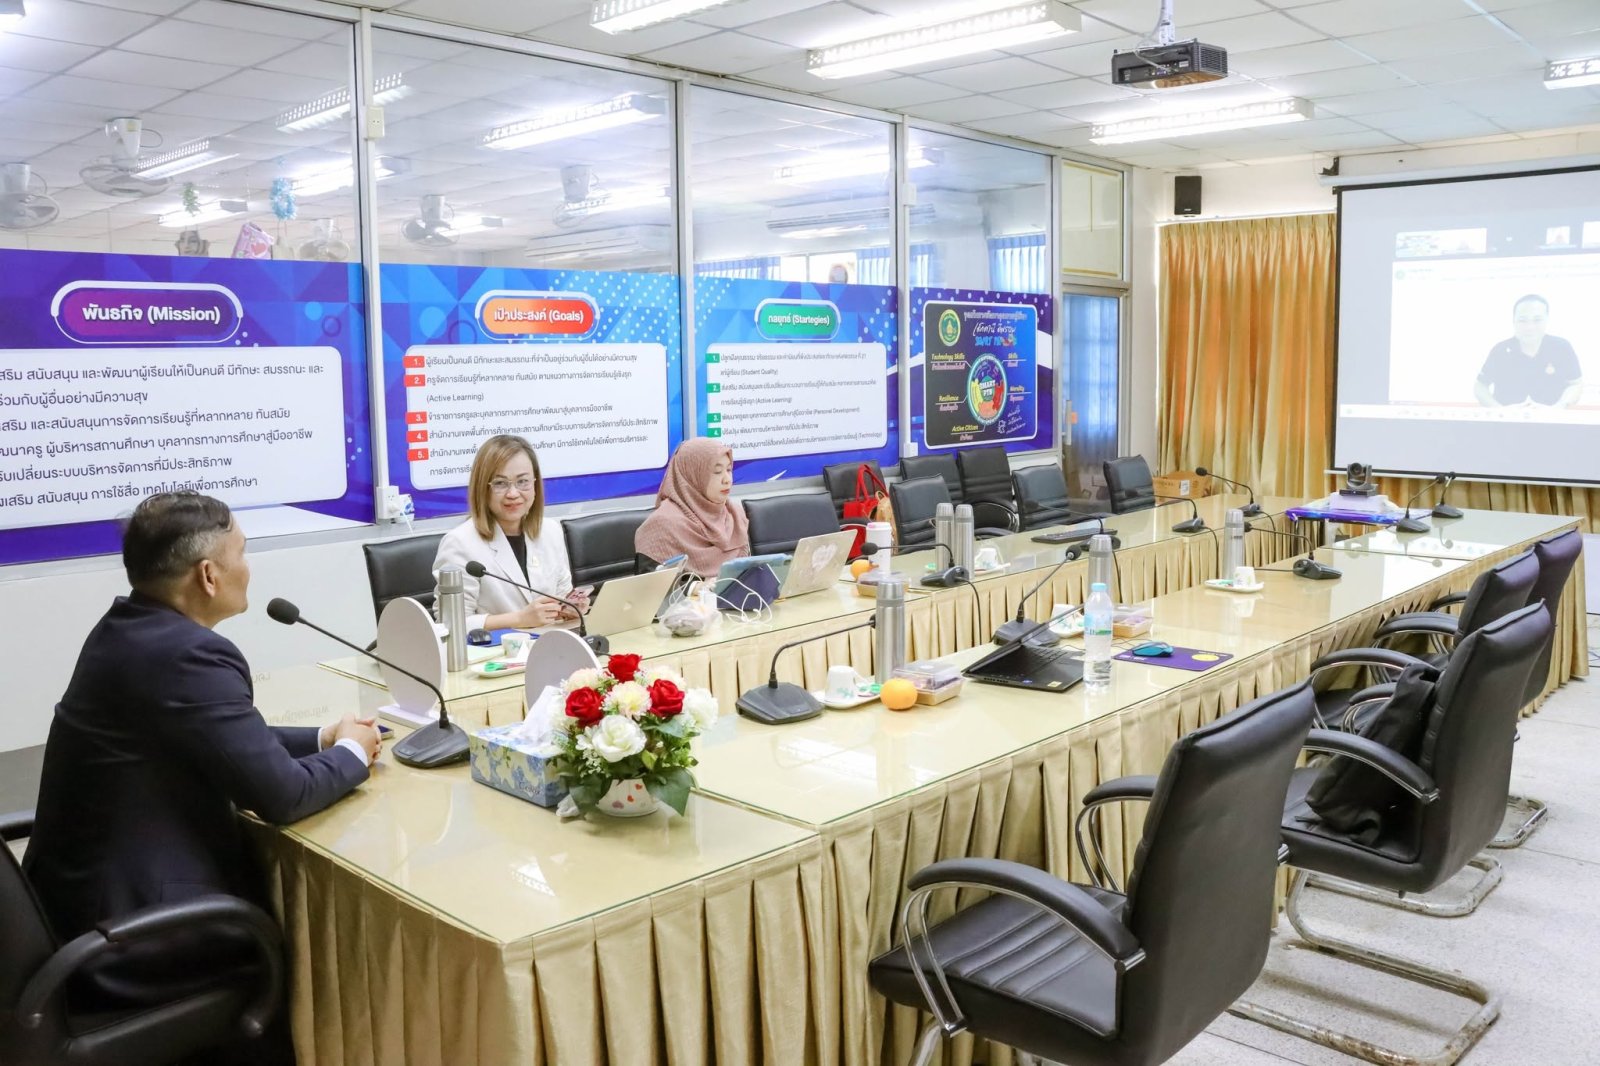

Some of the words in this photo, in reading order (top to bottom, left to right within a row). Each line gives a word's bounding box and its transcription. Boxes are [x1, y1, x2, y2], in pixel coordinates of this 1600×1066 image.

[82, 303, 143, 320] พันธกิจ
[147, 305, 221, 324] (Mission)
[494, 306, 547, 321] เป้าประสงค์
[549, 309, 584, 324] (Goals)
[26, 368, 79, 383] สนับสนุน
[227, 364, 261, 376] มีทักษะ
[263, 364, 306, 375] สมรรถนะ
[309, 364, 324, 374] และ
[426, 394, 451, 403] (Active
[452, 392, 485, 402] Learning)
[256, 408, 291, 420] ทันสมัย
[415, 414, 423, 422] 3.
[46, 437, 155, 457] ผู้บริหารสถานศึกษา
[417, 451, 425, 459] 5.
[37, 491, 88, 504] สนับสนุน
[91, 481, 140, 500] การใช้สื่อ
